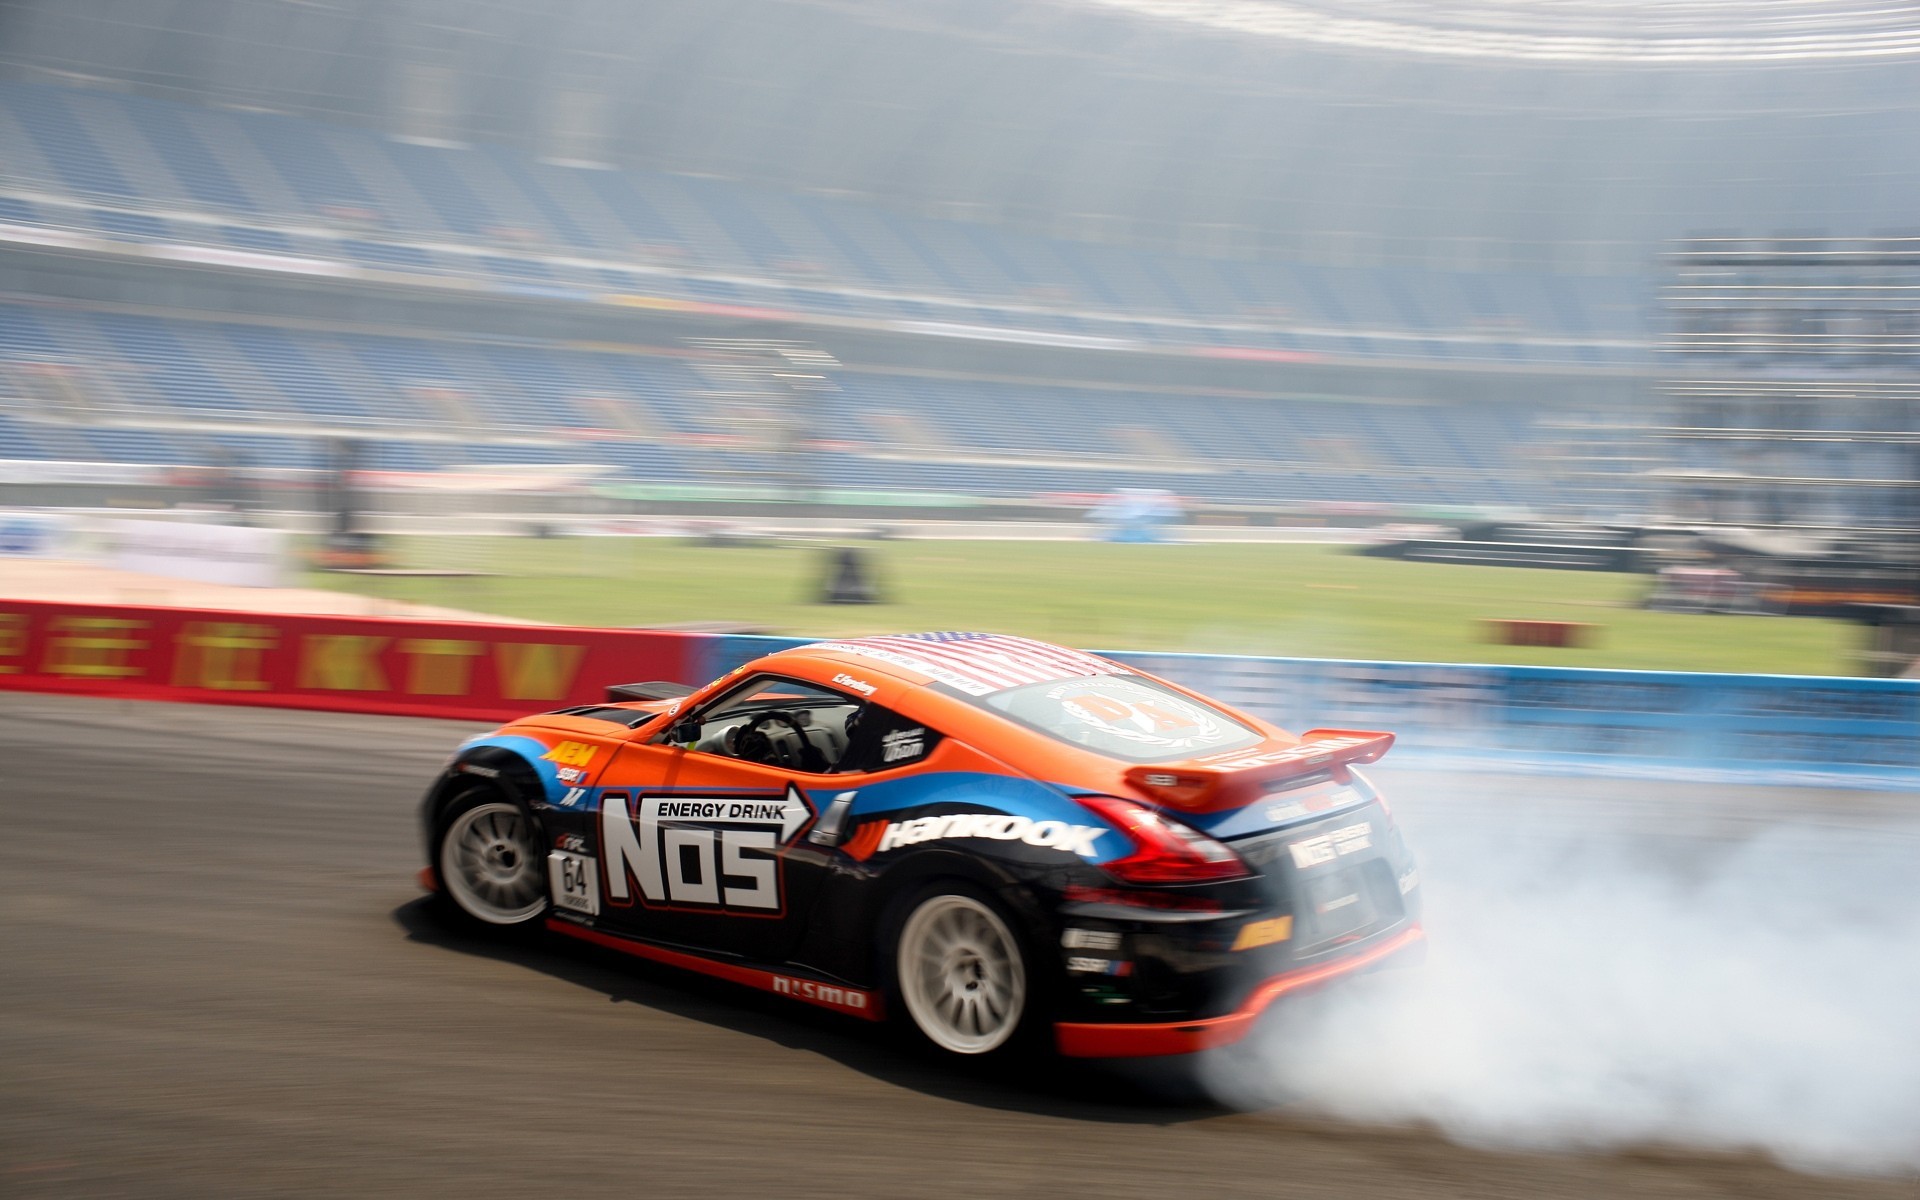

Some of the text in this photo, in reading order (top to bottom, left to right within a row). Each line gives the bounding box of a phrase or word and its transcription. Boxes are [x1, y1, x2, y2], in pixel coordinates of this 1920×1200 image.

[657, 803, 788, 820] ENERGY DRINK
[602, 797, 780, 910] NOS
[562, 856, 587, 896] 64
